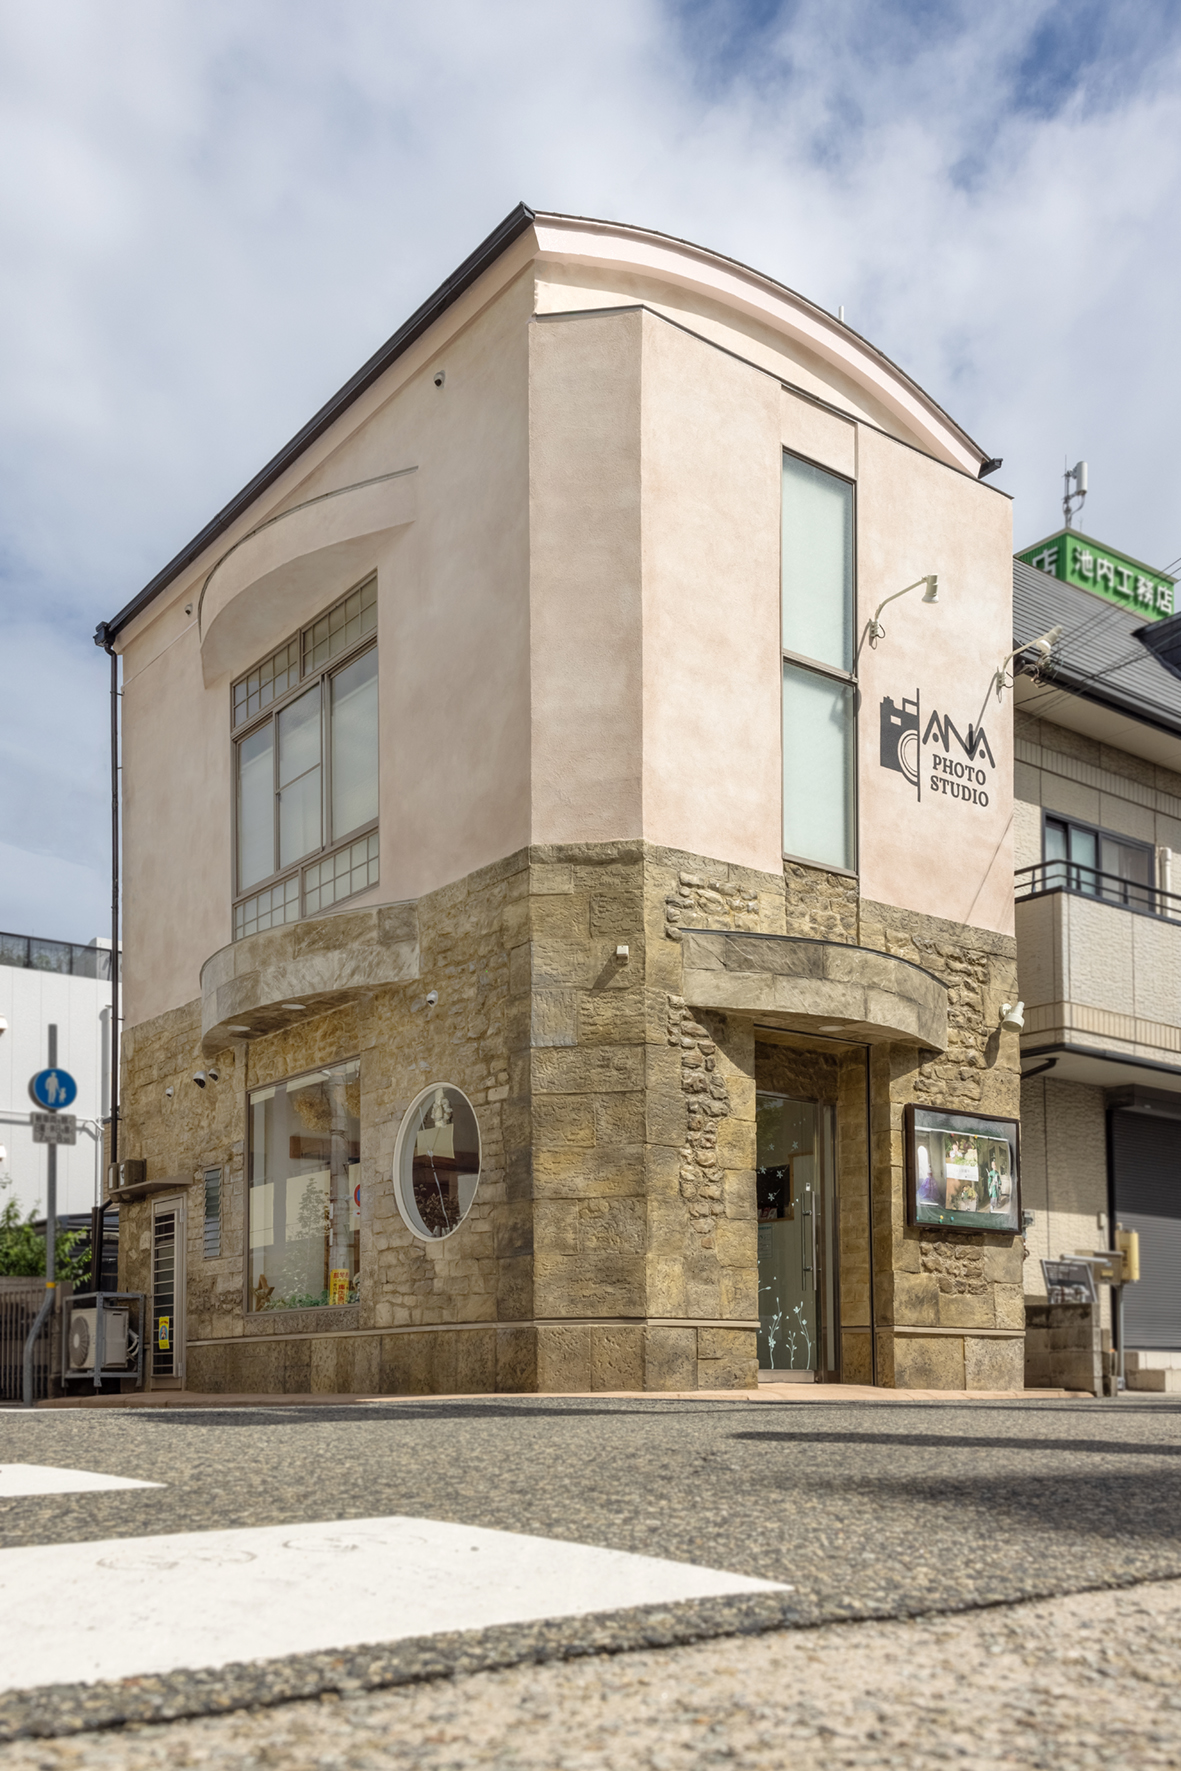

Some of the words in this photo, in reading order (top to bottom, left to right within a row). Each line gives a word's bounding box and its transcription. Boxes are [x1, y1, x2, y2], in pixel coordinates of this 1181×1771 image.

[1073, 545, 1174, 614] 池内工務店
[922, 709, 996, 769] ANA
[930, 775, 989, 808] STUDIO
[932, 753, 986, 786] PHOTO
